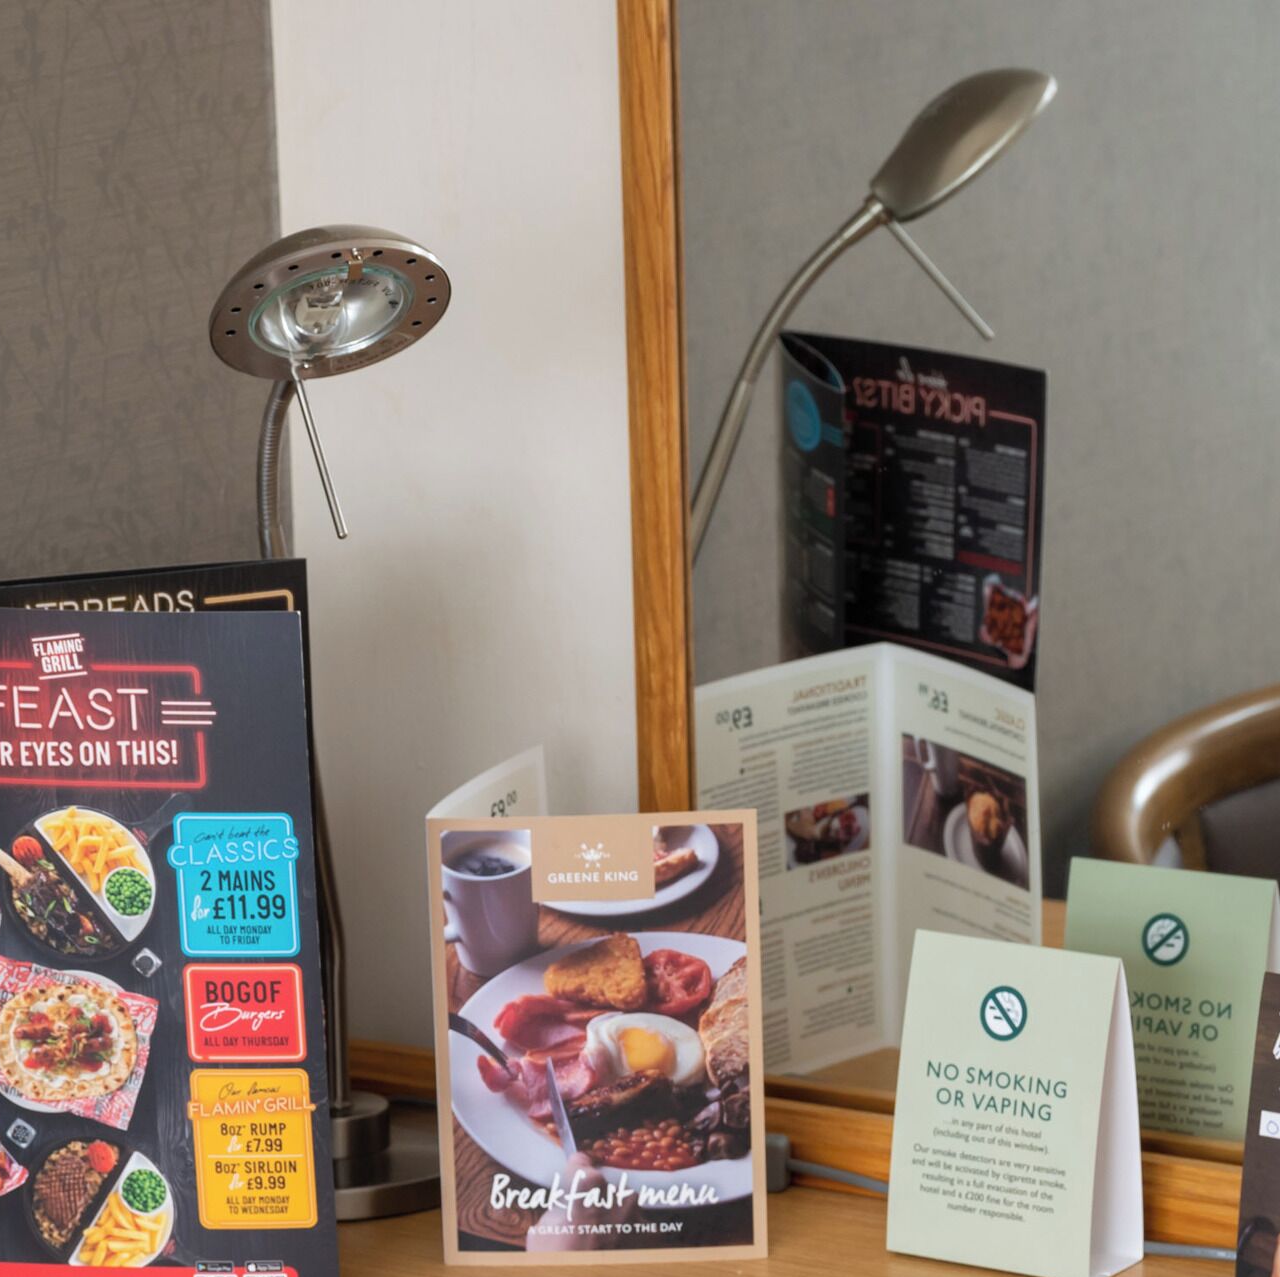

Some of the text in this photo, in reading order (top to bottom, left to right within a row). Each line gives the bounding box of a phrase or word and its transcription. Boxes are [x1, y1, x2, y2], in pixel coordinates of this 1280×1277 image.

[33, 638, 83, 657] FLAMING
[41, 654, 83, 674] GRILL
[20, 741, 74, 766] EYES
[79, 741, 111, 766] ON
[116, 740, 178, 765] THIS!
[254, 824, 270, 837] the
[170, 838, 297, 866] CLASSICS
[200, 870, 275, 891] 2 MAINS
[547, 871, 639, 884] GREENE KING
[191, 894, 286, 921] for £11.99
[207, 925, 272, 934] ALL DAY MONDAY
[220, 936, 260, 944] TO FRIDAY
[205, 981, 282, 1003] BOGOF
[200, 1002, 285, 1032] Burgers
[204, 1036, 289, 1047] ALL DAY THURSDAY
[927, 1061, 1068, 1098] NO SMOKING
[189, 1097, 316, 1118] FLAMIN' GRILL
[936, 1088, 1052, 1121] OR VAPING
[250, 1123, 286, 1135] RUMP
[975, 1122, 992, 1131] part
[1021, 1128, 1042, 1139] hotel
[246, 1138, 283, 1153] £7.99
[913, 1143, 929, 1153] Our
[932, 1148, 956, 1158] smoke
[960, 1151, 996, 1165] detectors
[244, 1160, 297, 1174] SIRLOIN
[247, 1176, 286, 1190] £9.99
[226, 1195, 290, 1205] ALL DAY MONDAY
[490, 1169, 719, 1222] Breakfast menu
[229, 1205, 288, 1214] TO WEDNESDAY
[538, 1225, 574, 1235] GREAT
[578, 1225, 613, 1235] START
[616, 1224, 632, 1234] TO
[633, 1223, 656, 1233] THE
[660, 1222, 683, 1233] DAY
